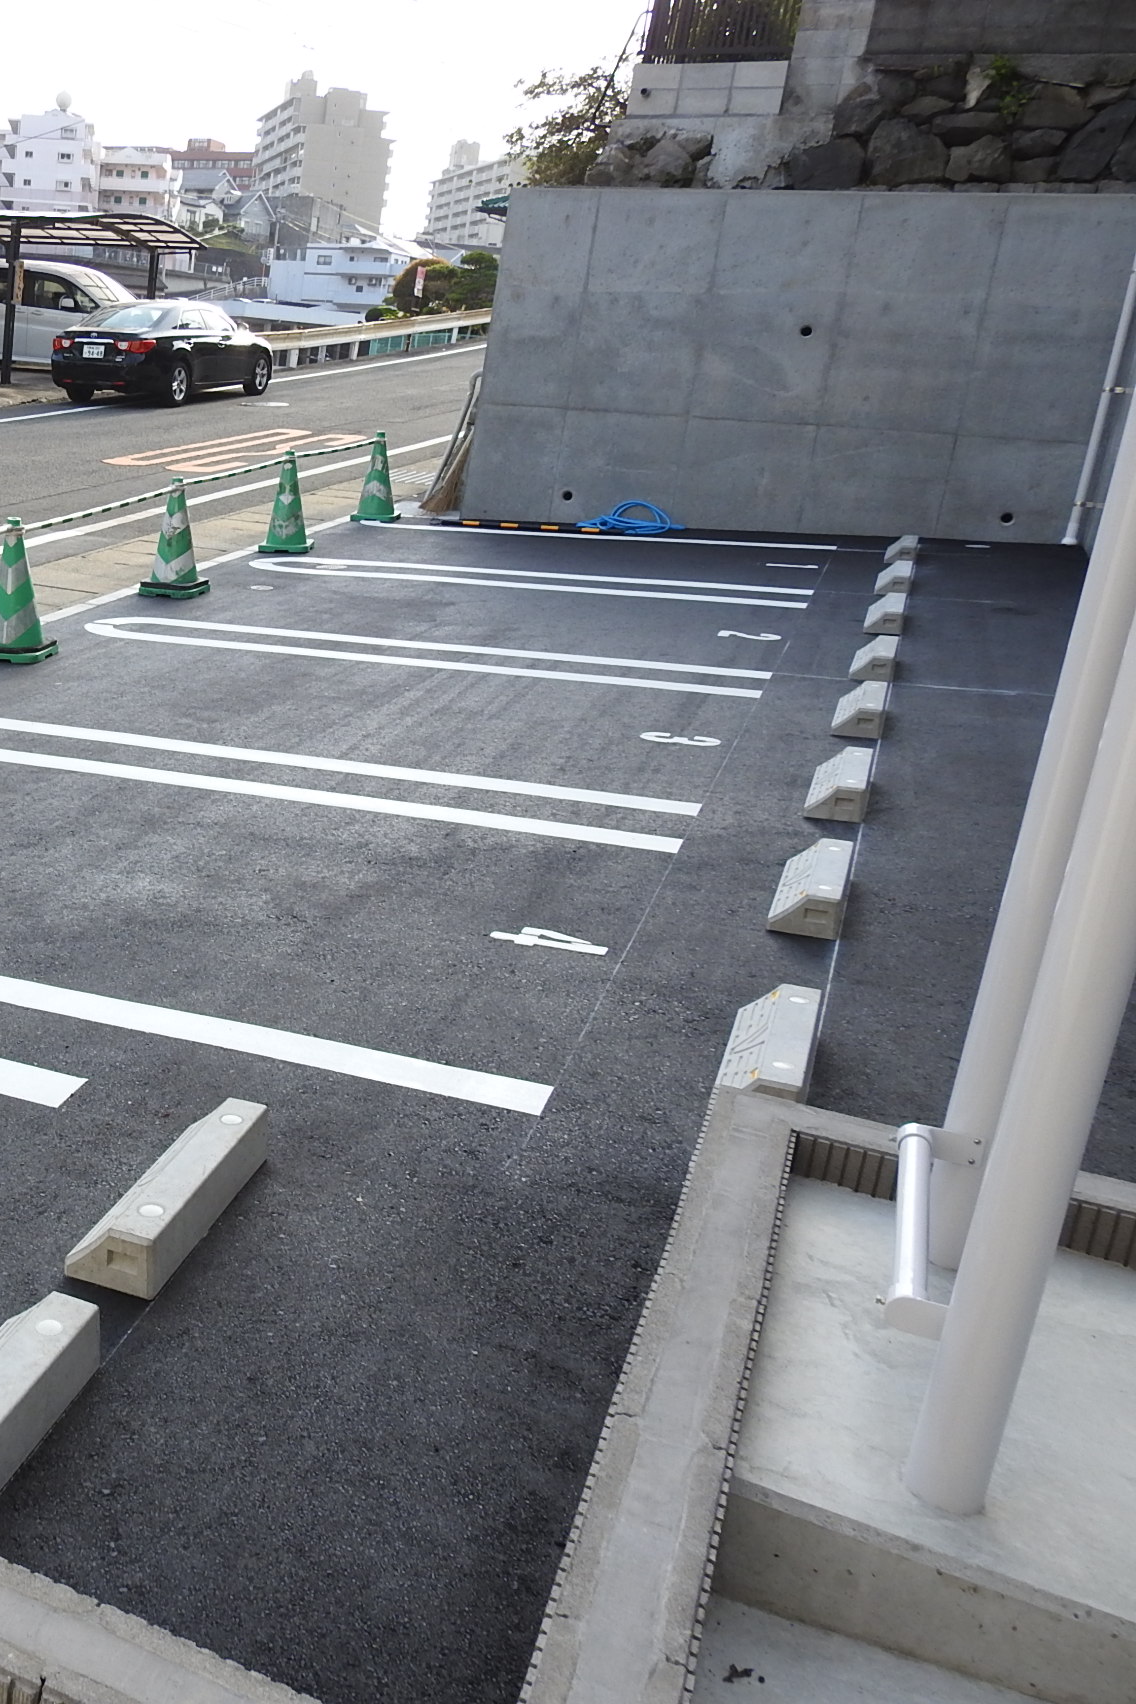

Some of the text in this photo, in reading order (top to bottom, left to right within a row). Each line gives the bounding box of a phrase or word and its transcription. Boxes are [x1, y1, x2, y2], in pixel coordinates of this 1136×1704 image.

[101, 428, 367, 472] 30
[717, 630, 782, 641] 2
[639, 731, 722, 747] 3
[490, 926, 609, 956] 4
